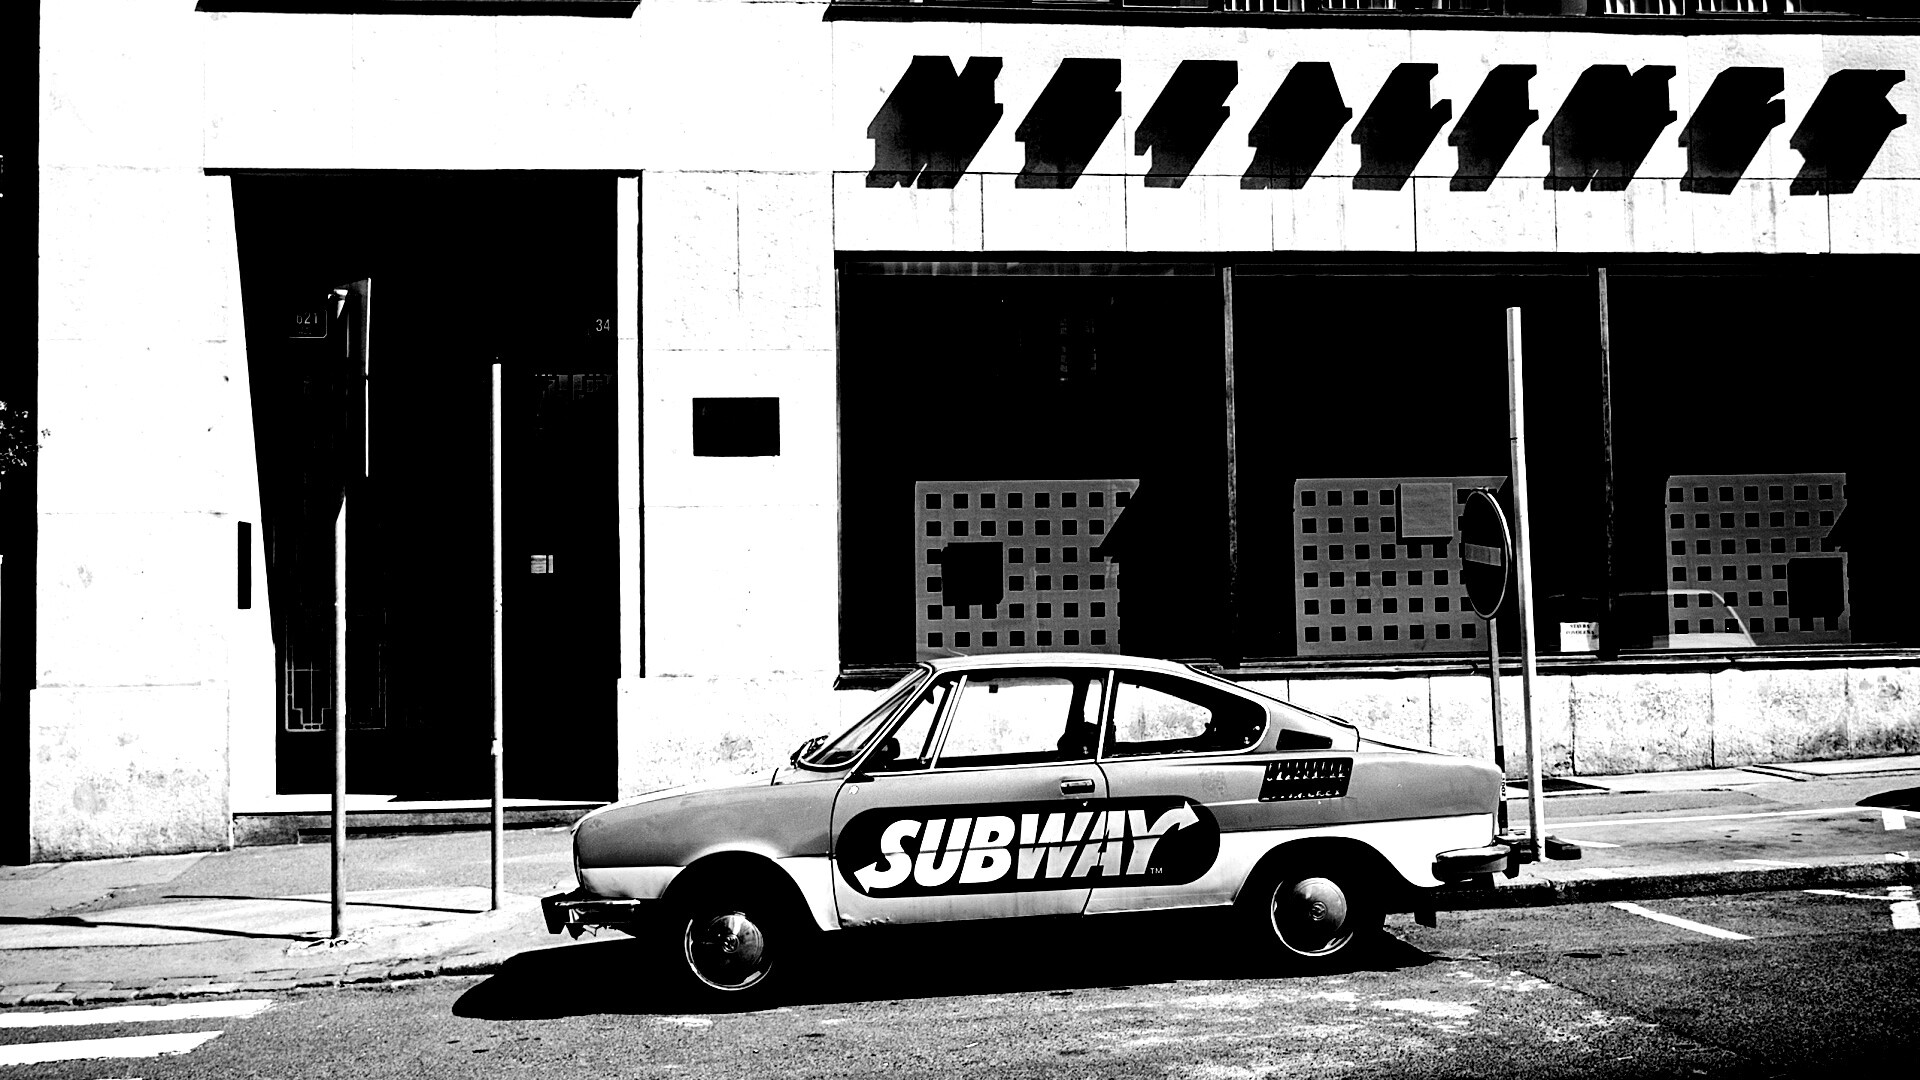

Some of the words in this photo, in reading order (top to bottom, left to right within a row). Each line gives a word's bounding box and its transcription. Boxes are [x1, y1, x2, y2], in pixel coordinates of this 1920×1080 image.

[595, 318, 610, 332] 34
[854, 801, 1200, 894] SUBWAY
[1150, 867, 1163, 875] TM
